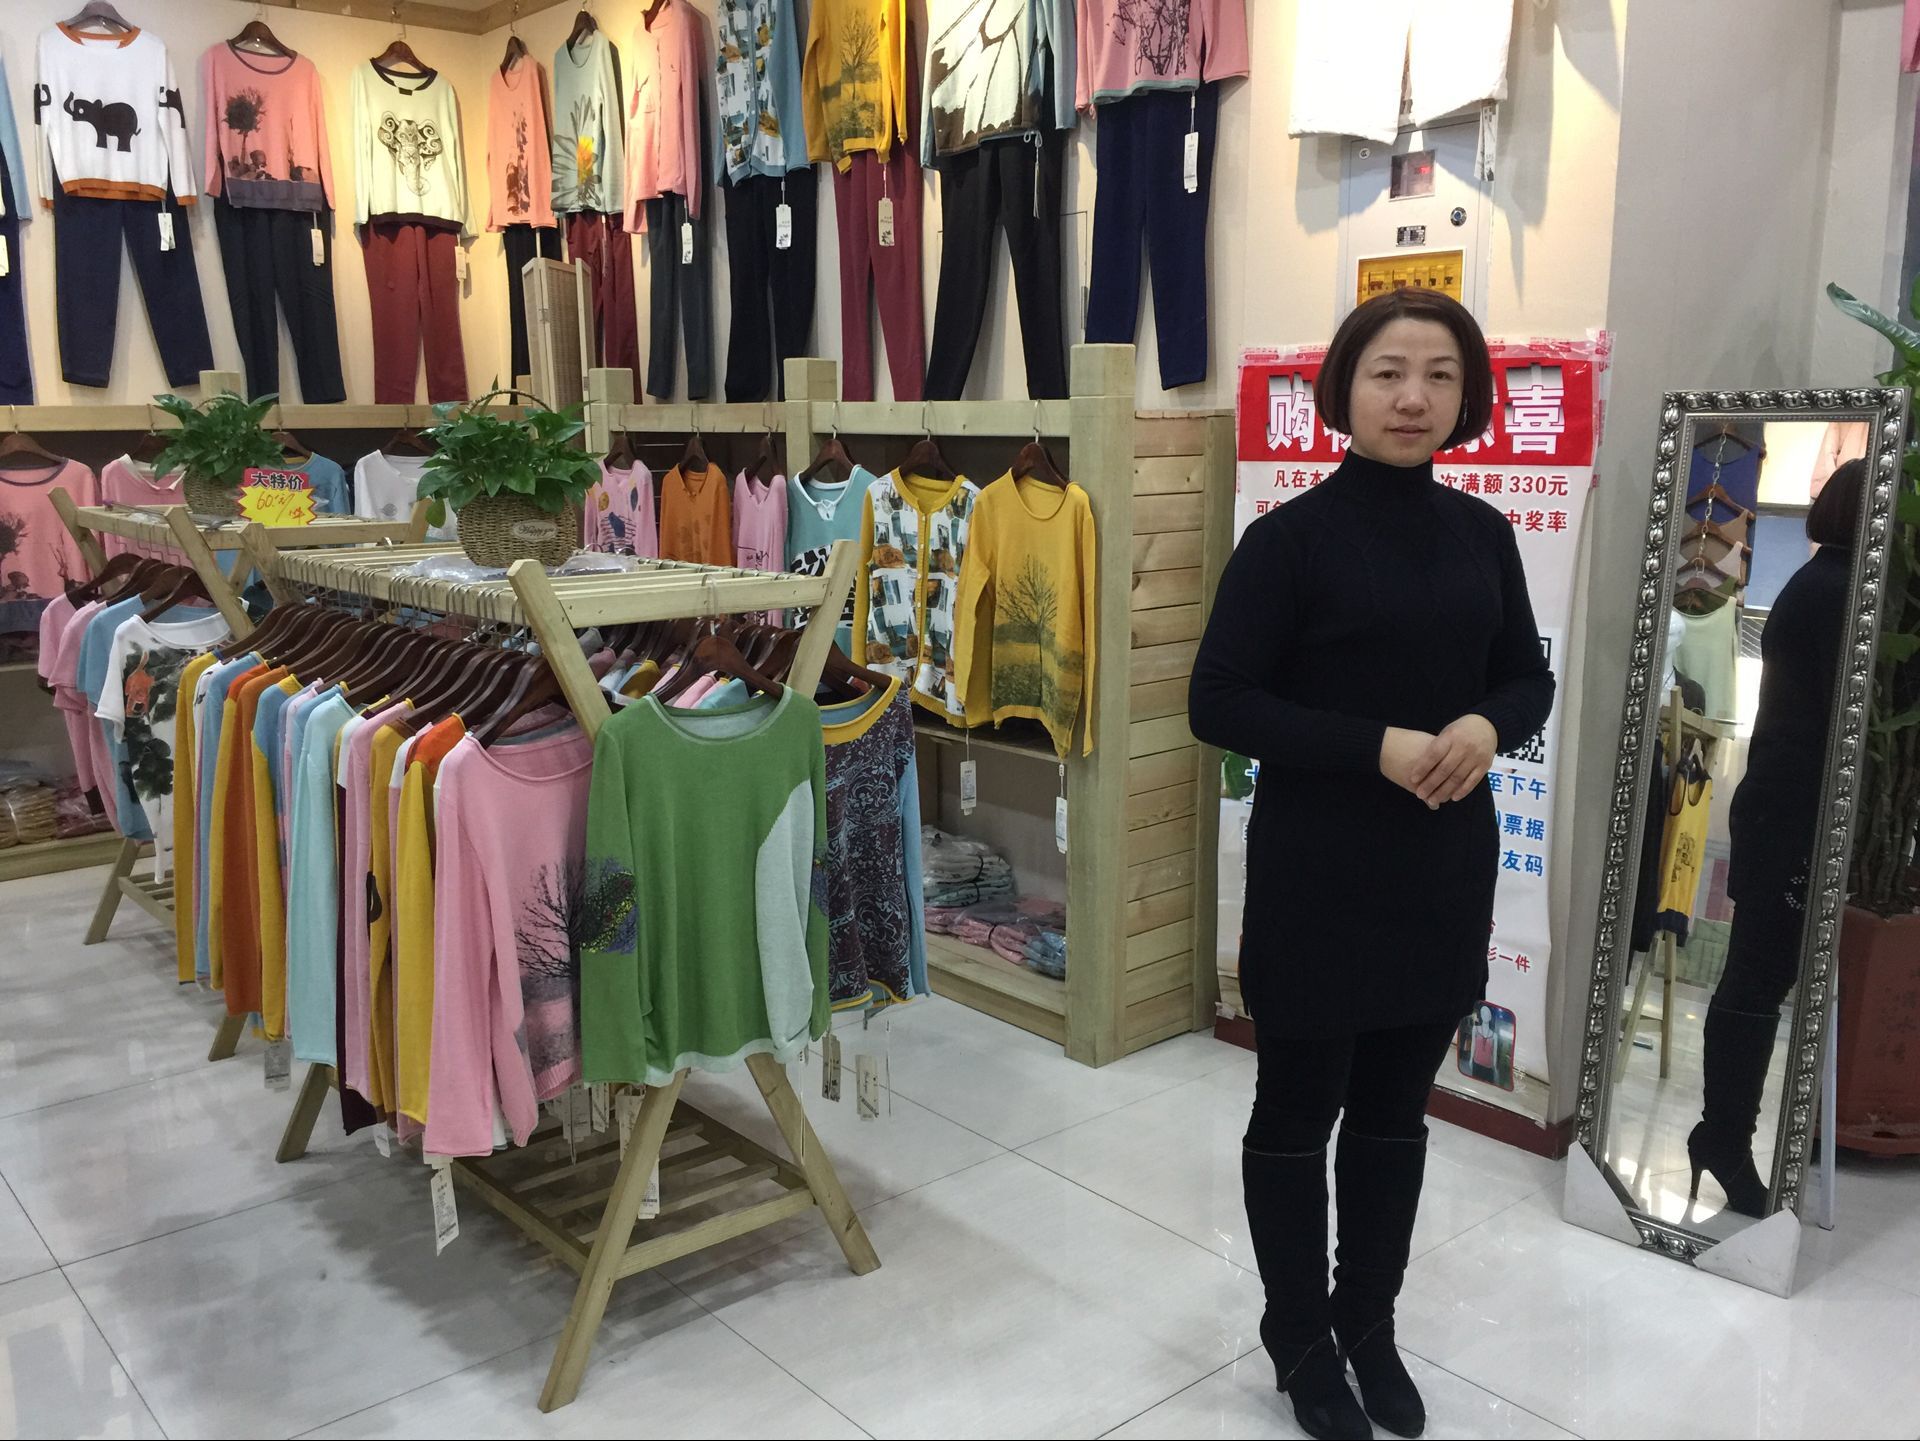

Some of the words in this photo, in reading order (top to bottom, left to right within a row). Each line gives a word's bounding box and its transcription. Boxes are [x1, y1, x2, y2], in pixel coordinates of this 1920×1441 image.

[251, 471, 304, 491] 大特价
[1488, 771, 1547, 800] 至下午
[1502, 850, 1543, 877] 友码
